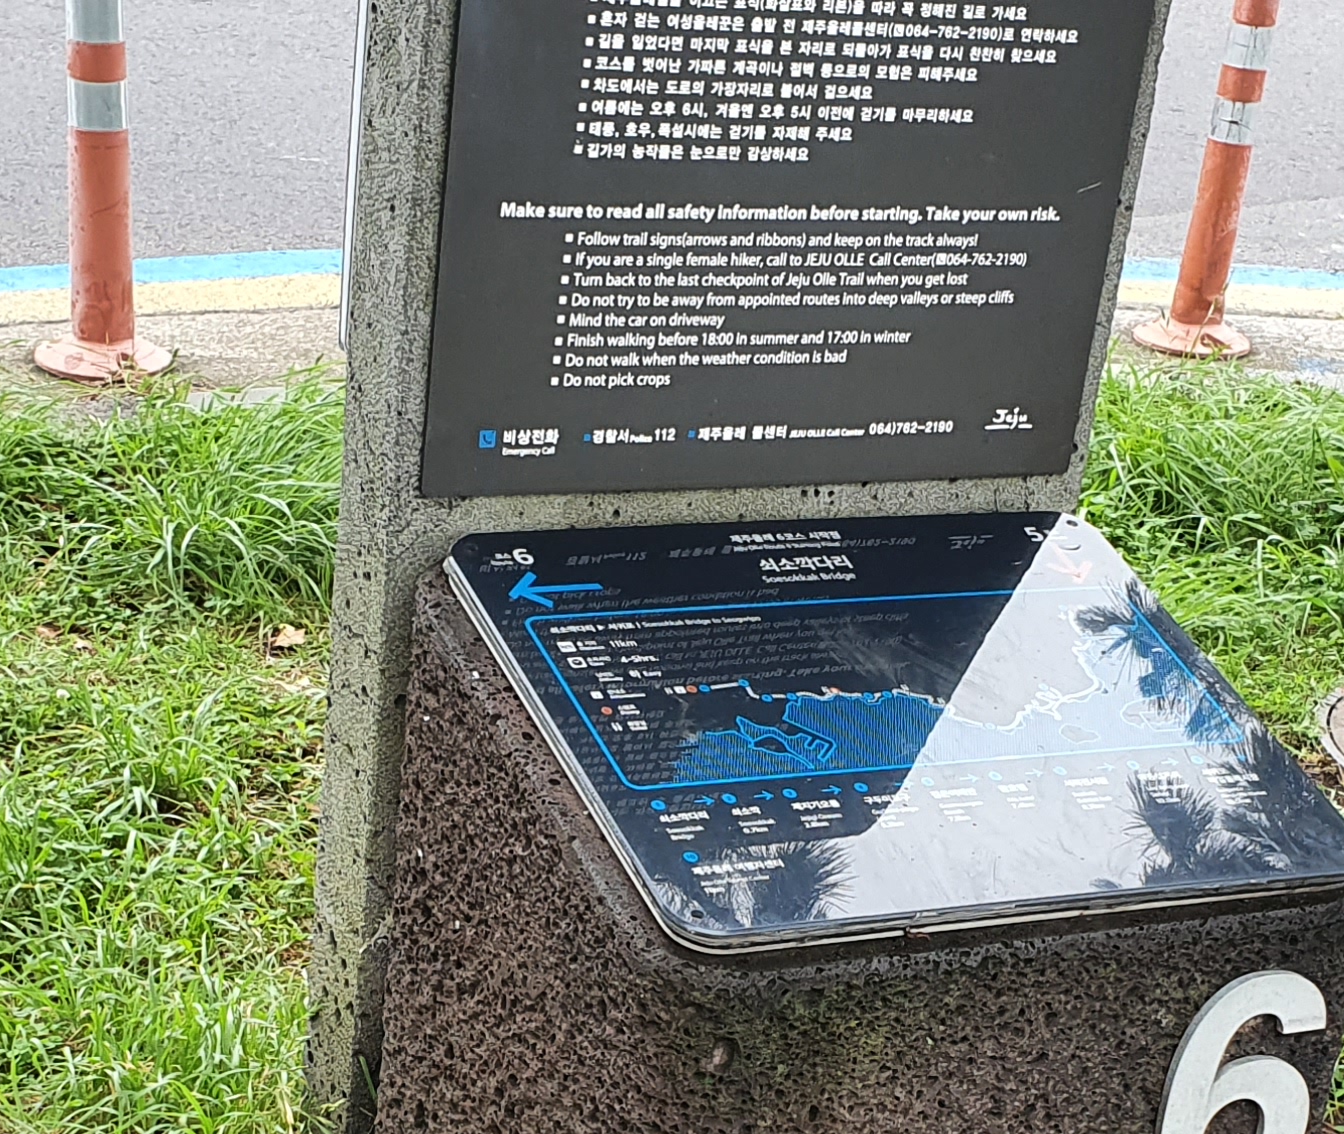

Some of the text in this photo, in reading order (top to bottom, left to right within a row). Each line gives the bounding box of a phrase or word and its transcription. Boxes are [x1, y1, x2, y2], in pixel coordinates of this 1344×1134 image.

[499, 201, 1061, 225] Make sure to read all safety information before starting. Take your own risk.
[577, 231, 979, 250] Follow trail signs(arrows and ribbons) and keep on the track always!
[575, 251, 587, 266] If
[585, 255, 611, 270] you
[612, 255, 635, 267] are
[635, 255, 644, 267] a
[646, 251, 684, 270] single
[685, 251, 729, 267] female
[729, 251, 764, 269] hiker,
[765, 252, 788, 267] call
[789, 254, 803, 267] to
[803, 252, 833, 267] JEJU
[833, 252, 866, 267] OLLE
[868, 252, 892, 267] Call
[568, 312, 726, 330] Mind the car on driveway
[566, 329, 912, 350] Finish walking before 18:00 in summer and 17:00 in winter
[564, 348, 848, 368] Do not walk when the weather condition is bad
[562, 371, 671, 390] Do not pick crops
[503, 428, 560, 446] 비상전화
[654, 427, 676, 441] 112
[869, 420, 954, 436] 064)762-2190
[512, 548, 535, 565] 6
[759, 554, 854, 573] 쇠소깍다리
[608, 639, 638, 648] 11km
